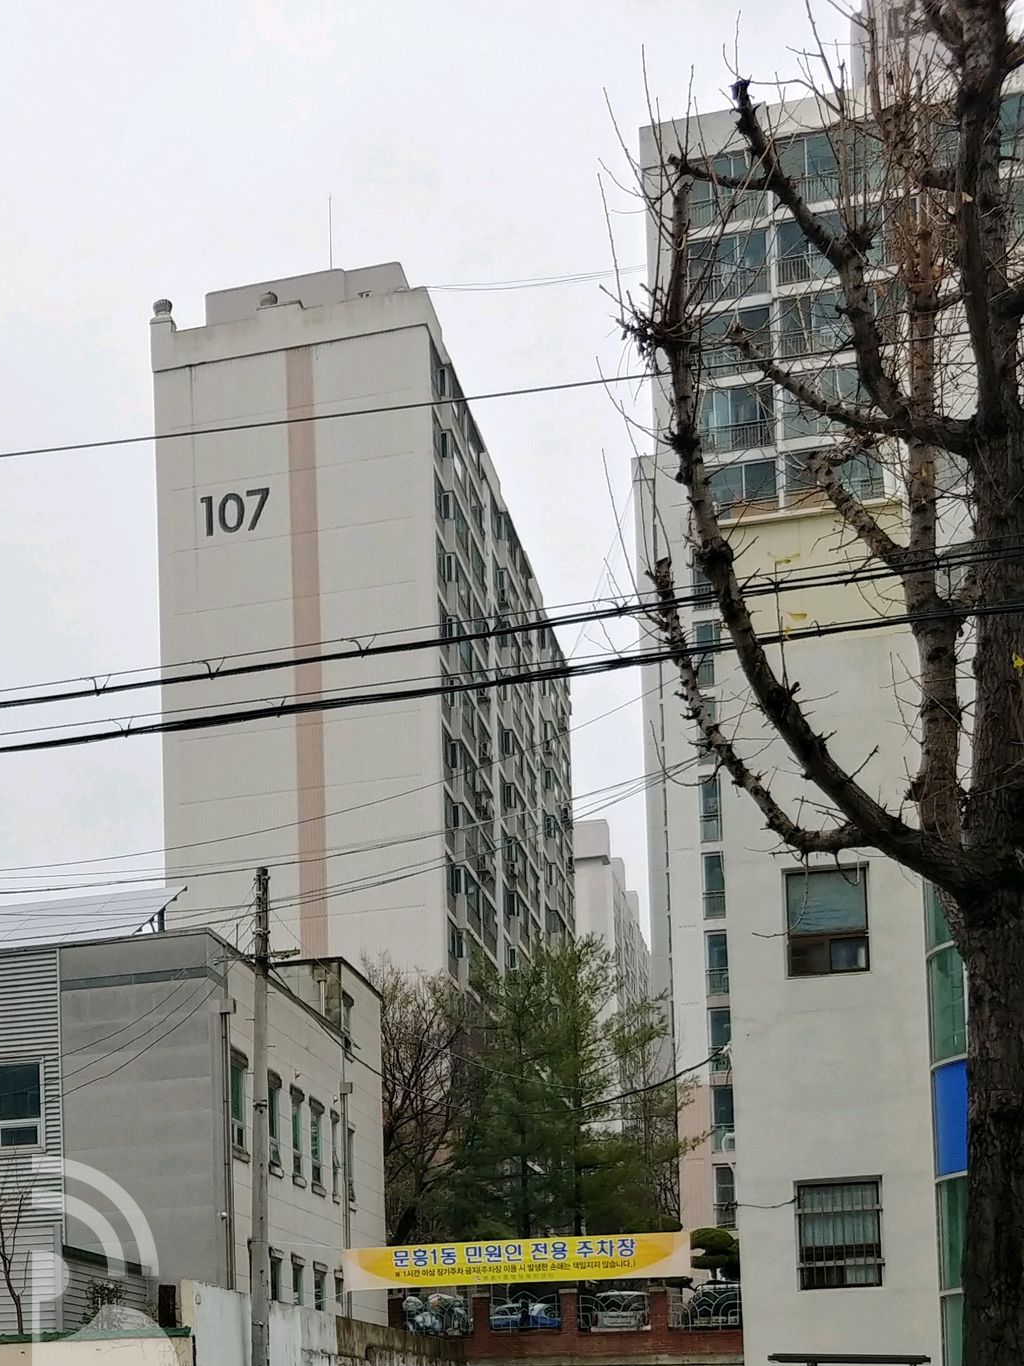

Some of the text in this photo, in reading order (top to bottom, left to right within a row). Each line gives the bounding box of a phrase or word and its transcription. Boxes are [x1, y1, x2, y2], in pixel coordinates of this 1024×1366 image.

[200, 487, 270, 537] 107
[393, 1238, 636, 1267] 문흥1동 민원인 전용 주차장
